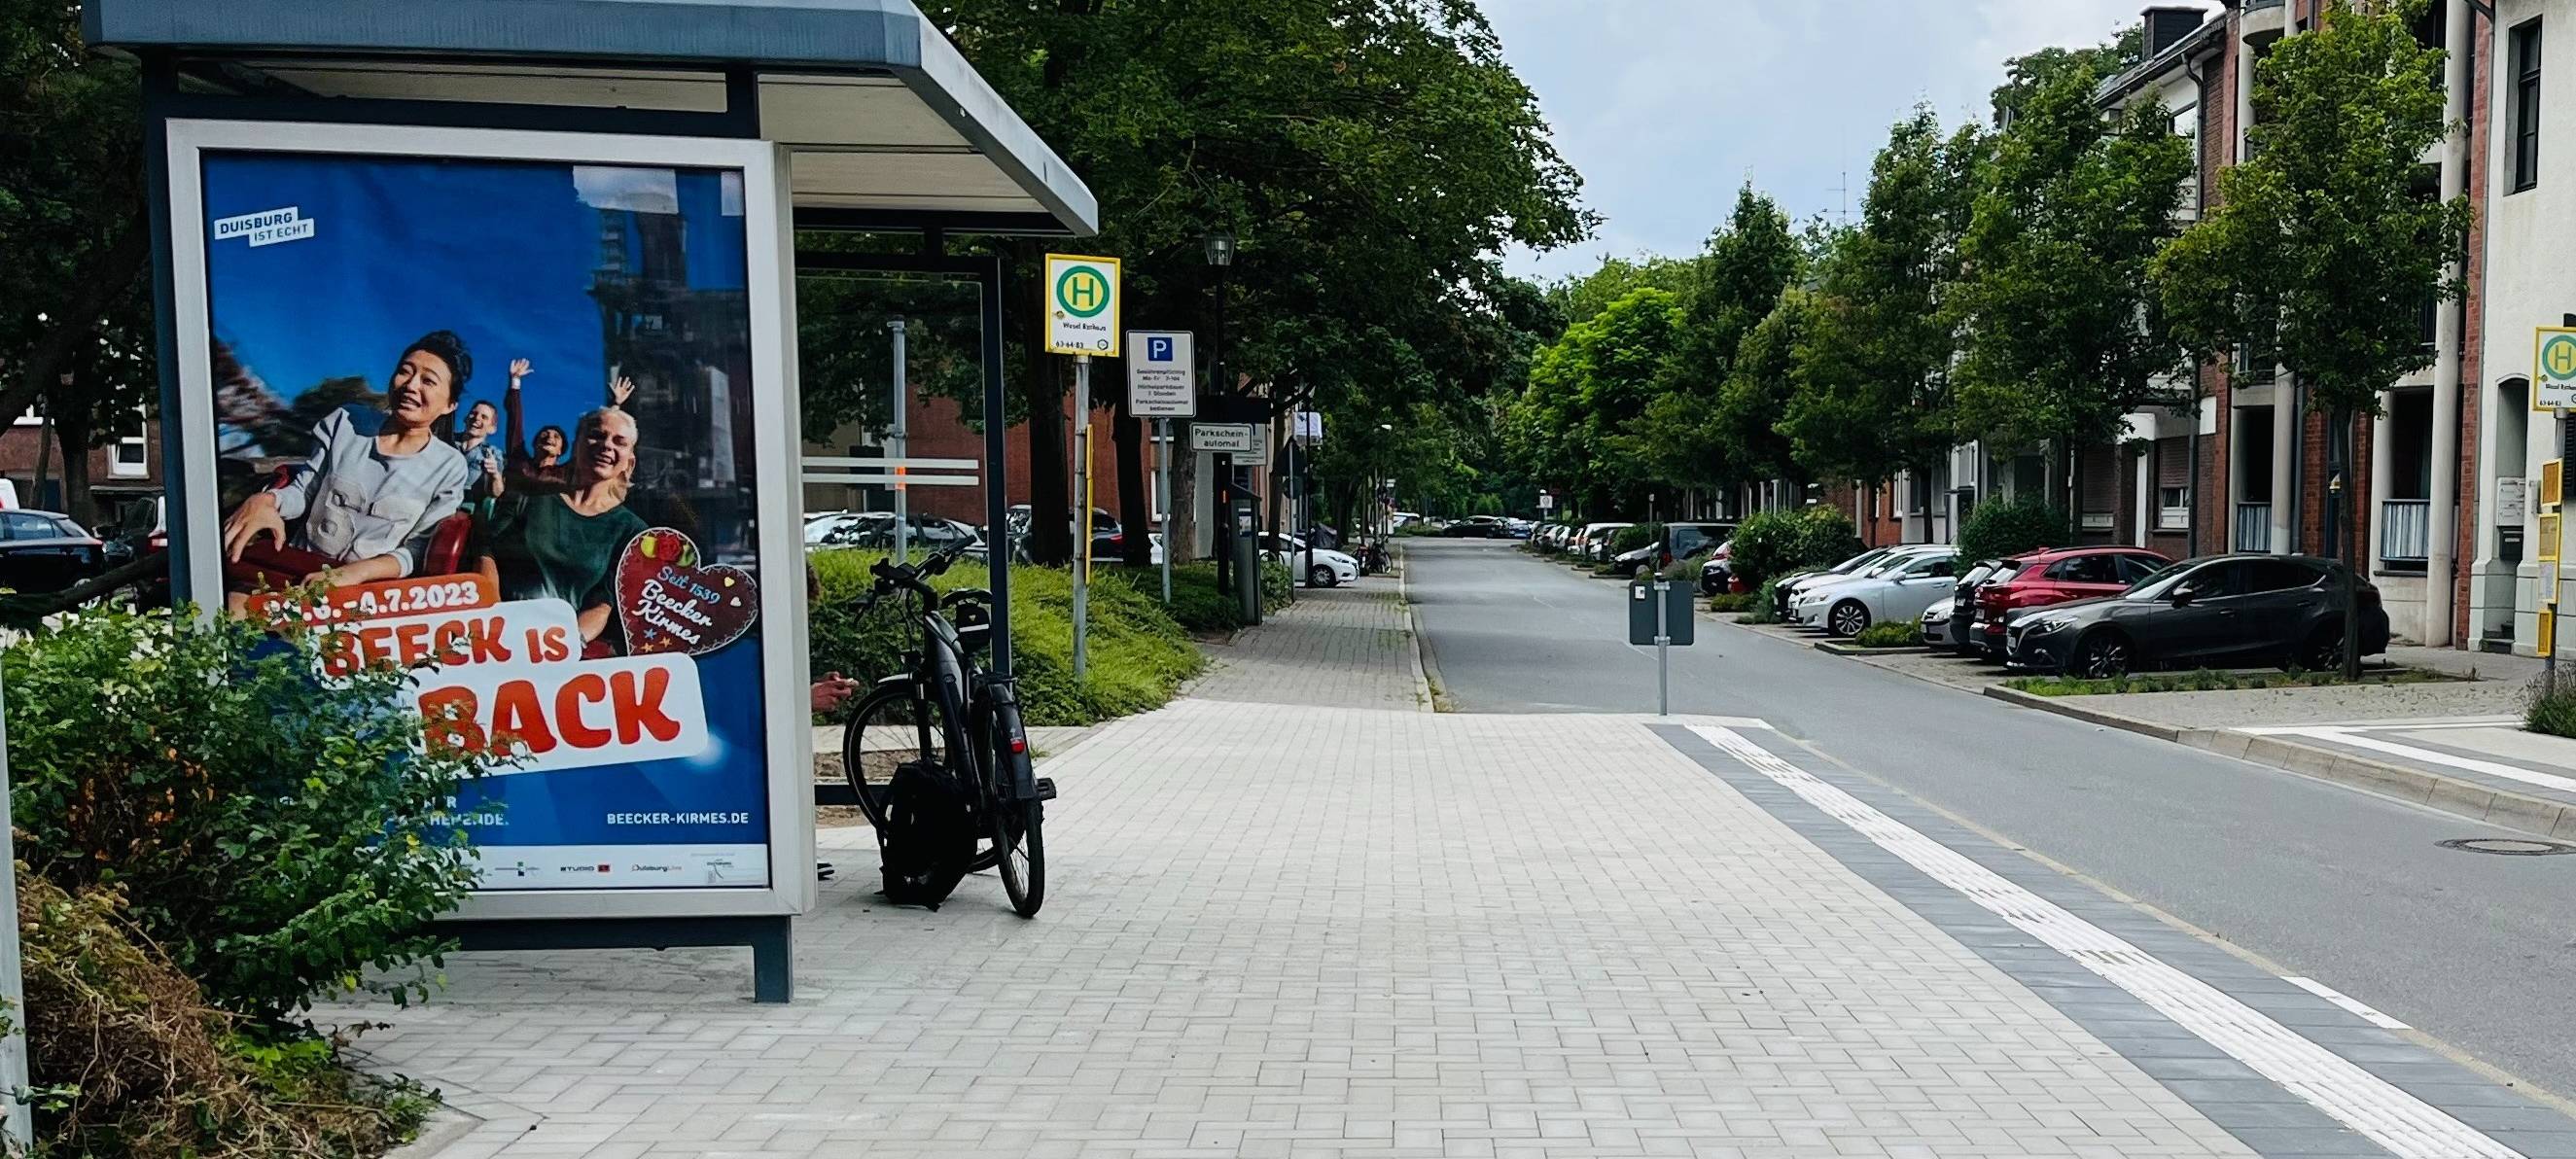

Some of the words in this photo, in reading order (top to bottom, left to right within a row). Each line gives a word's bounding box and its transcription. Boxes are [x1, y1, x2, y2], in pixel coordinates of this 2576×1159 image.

[220, 213, 293, 234] DUISBURG
[254, 230, 273, 242] IST
[276, 224, 308, 238] ECHT
[1072, 276, 1095, 306] H
[1153, 340, 1167, 359] P
[2555, 344, 2572, 370] H
[656, 566, 690, 589] Seit
[688, 583, 721, 605] 1539
[641, 579, 714, 627] Beecker
[631, 599, 701, 645] Kirmes
[319, 615, 512, 680] BEECK
[525, 626, 570, 664] IS
[417, 666, 681, 759] BACK
[607, 812, 749, 825] BEECKER-KIRMES.DE
